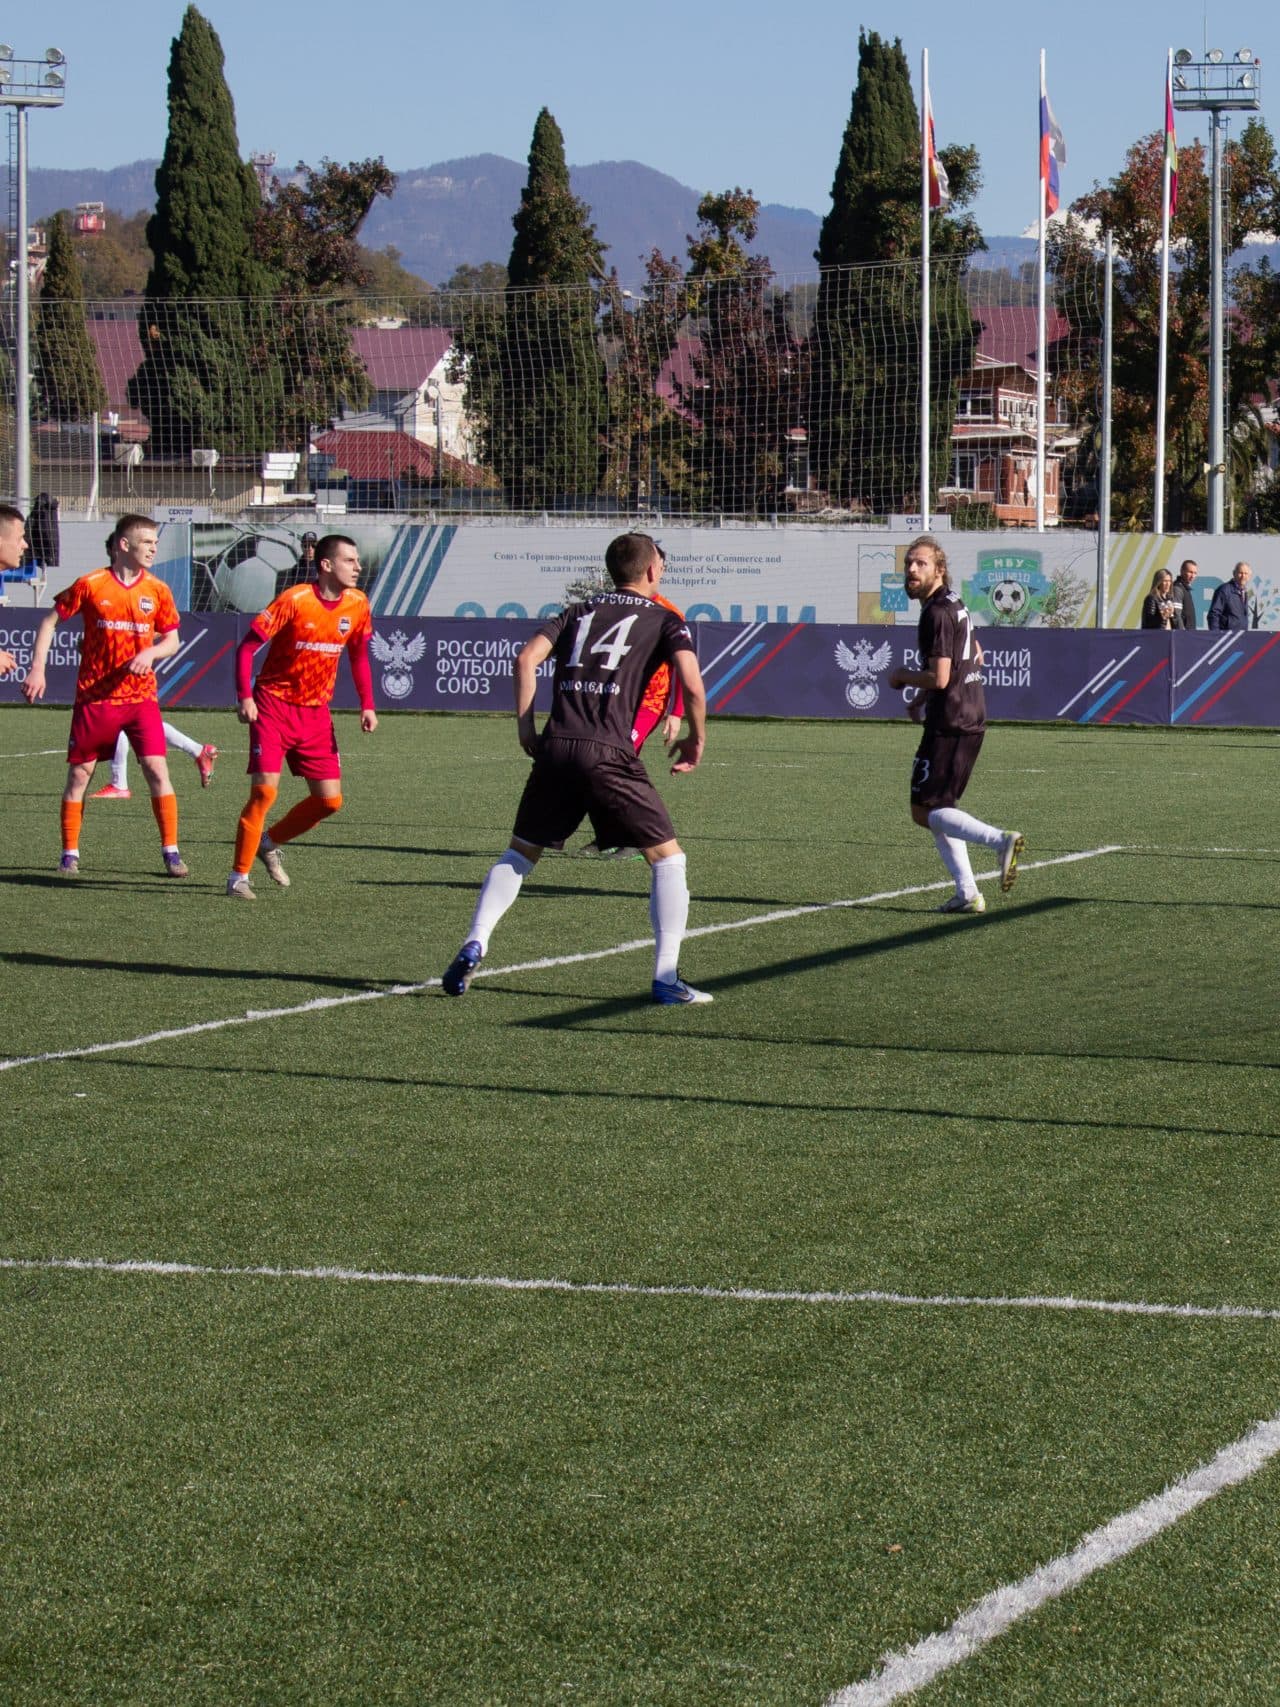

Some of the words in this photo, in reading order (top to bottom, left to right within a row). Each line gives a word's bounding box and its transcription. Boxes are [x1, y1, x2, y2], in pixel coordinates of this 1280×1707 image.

[765, 555, 782, 564] and
[436, 638, 527, 658] РОССИЙС
[565, 610, 639, 670] 14
[436, 677, 491, 695] СОЮЗ
